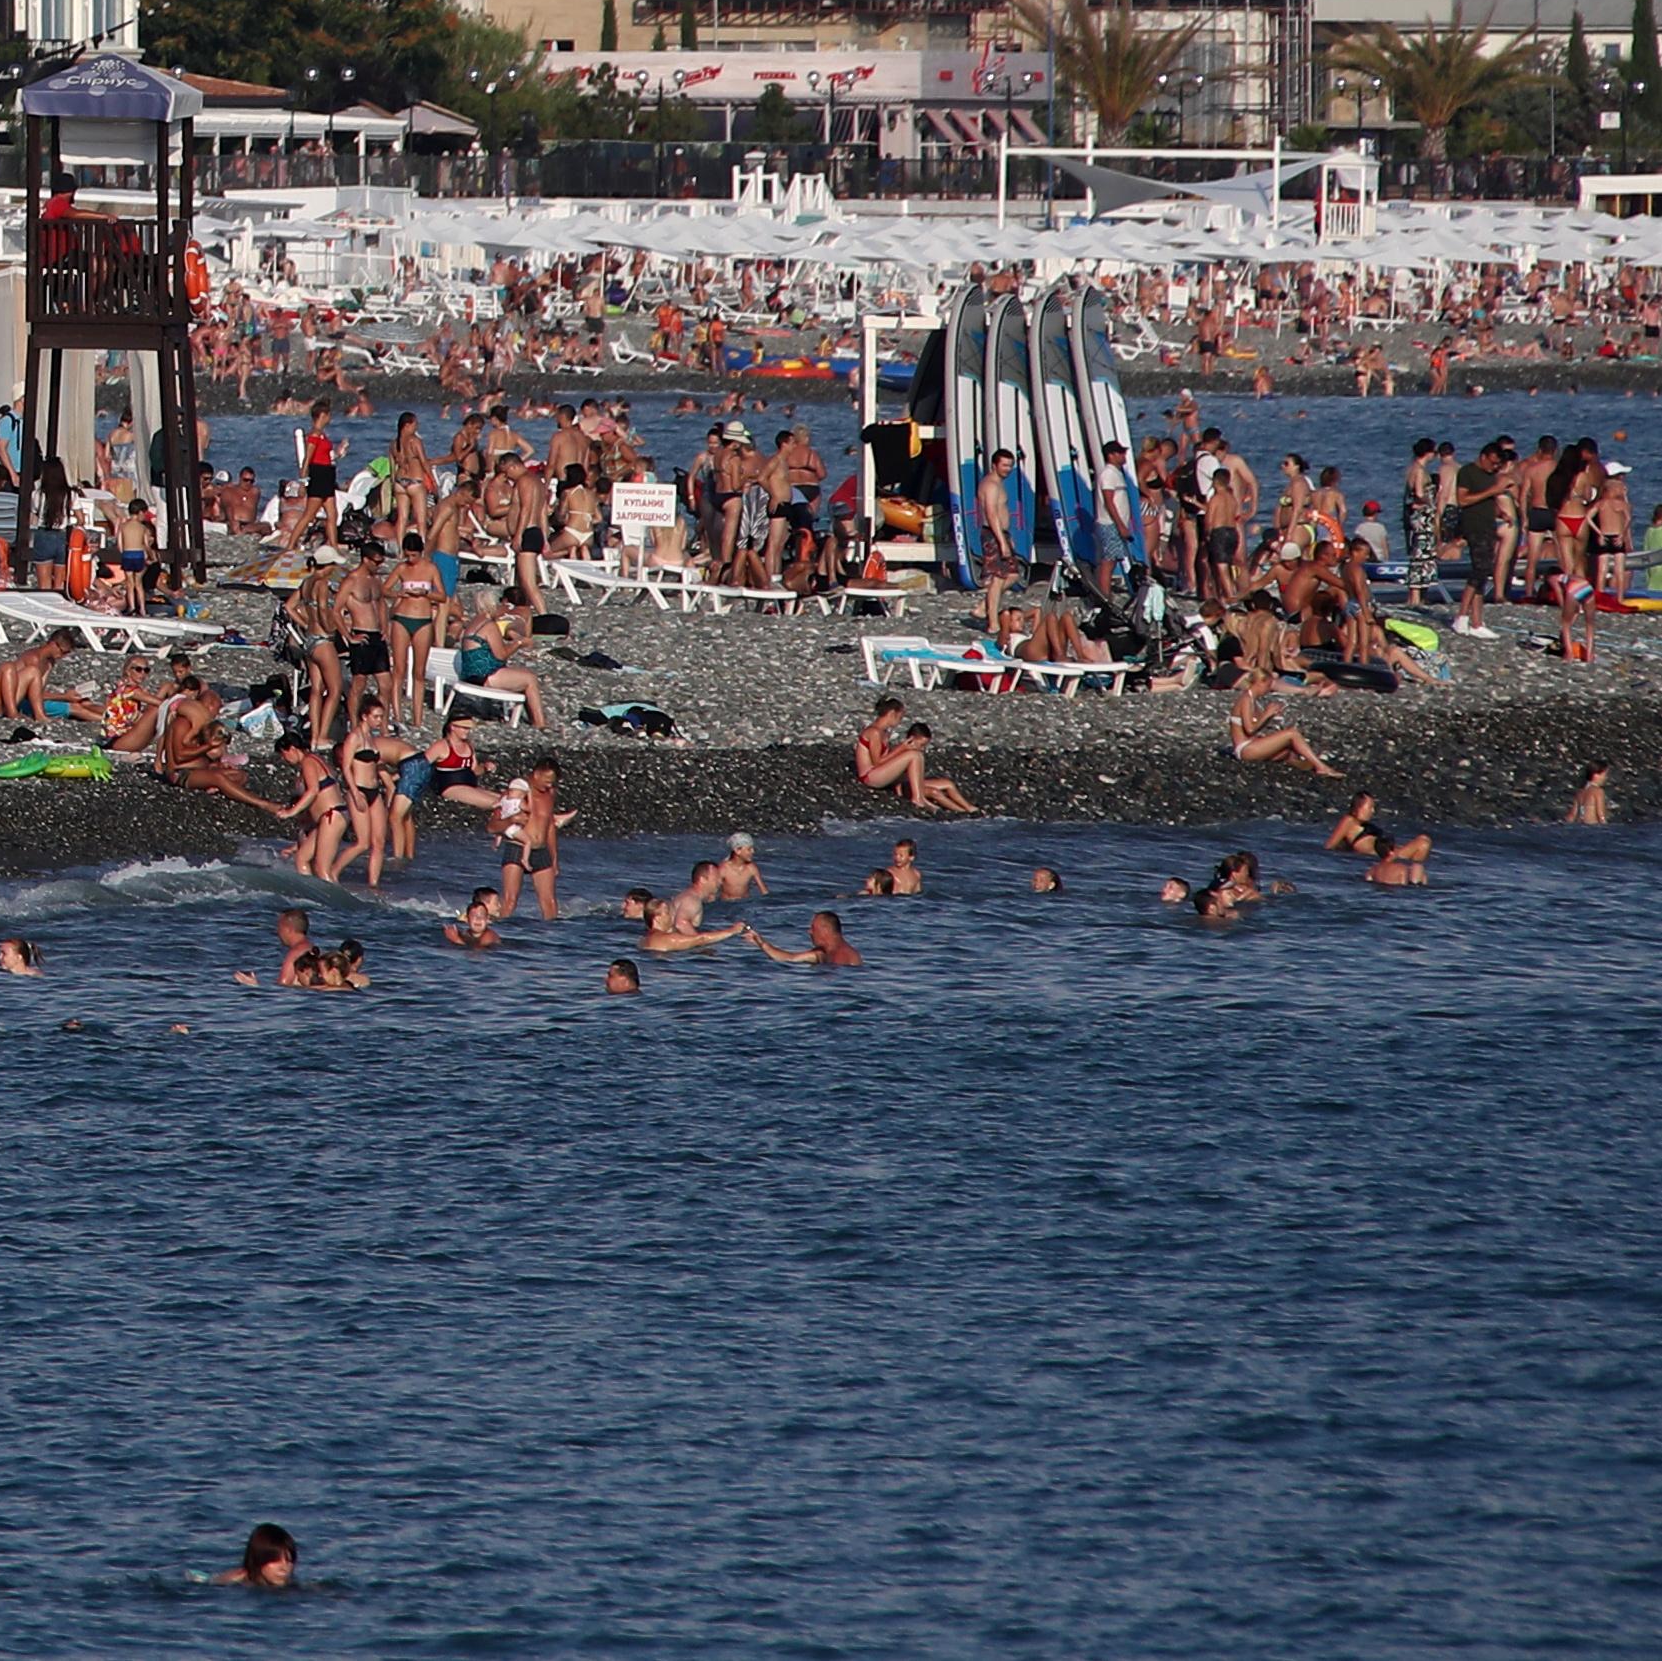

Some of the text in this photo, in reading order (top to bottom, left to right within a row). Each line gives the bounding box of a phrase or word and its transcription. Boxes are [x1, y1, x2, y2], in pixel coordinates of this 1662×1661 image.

[66, 75, 137, 87] Сириус
[623, 498, 665, 508] КУПАНИЕ
[616, 511, 672, 522] ЗАПРЕЩЕНО!
